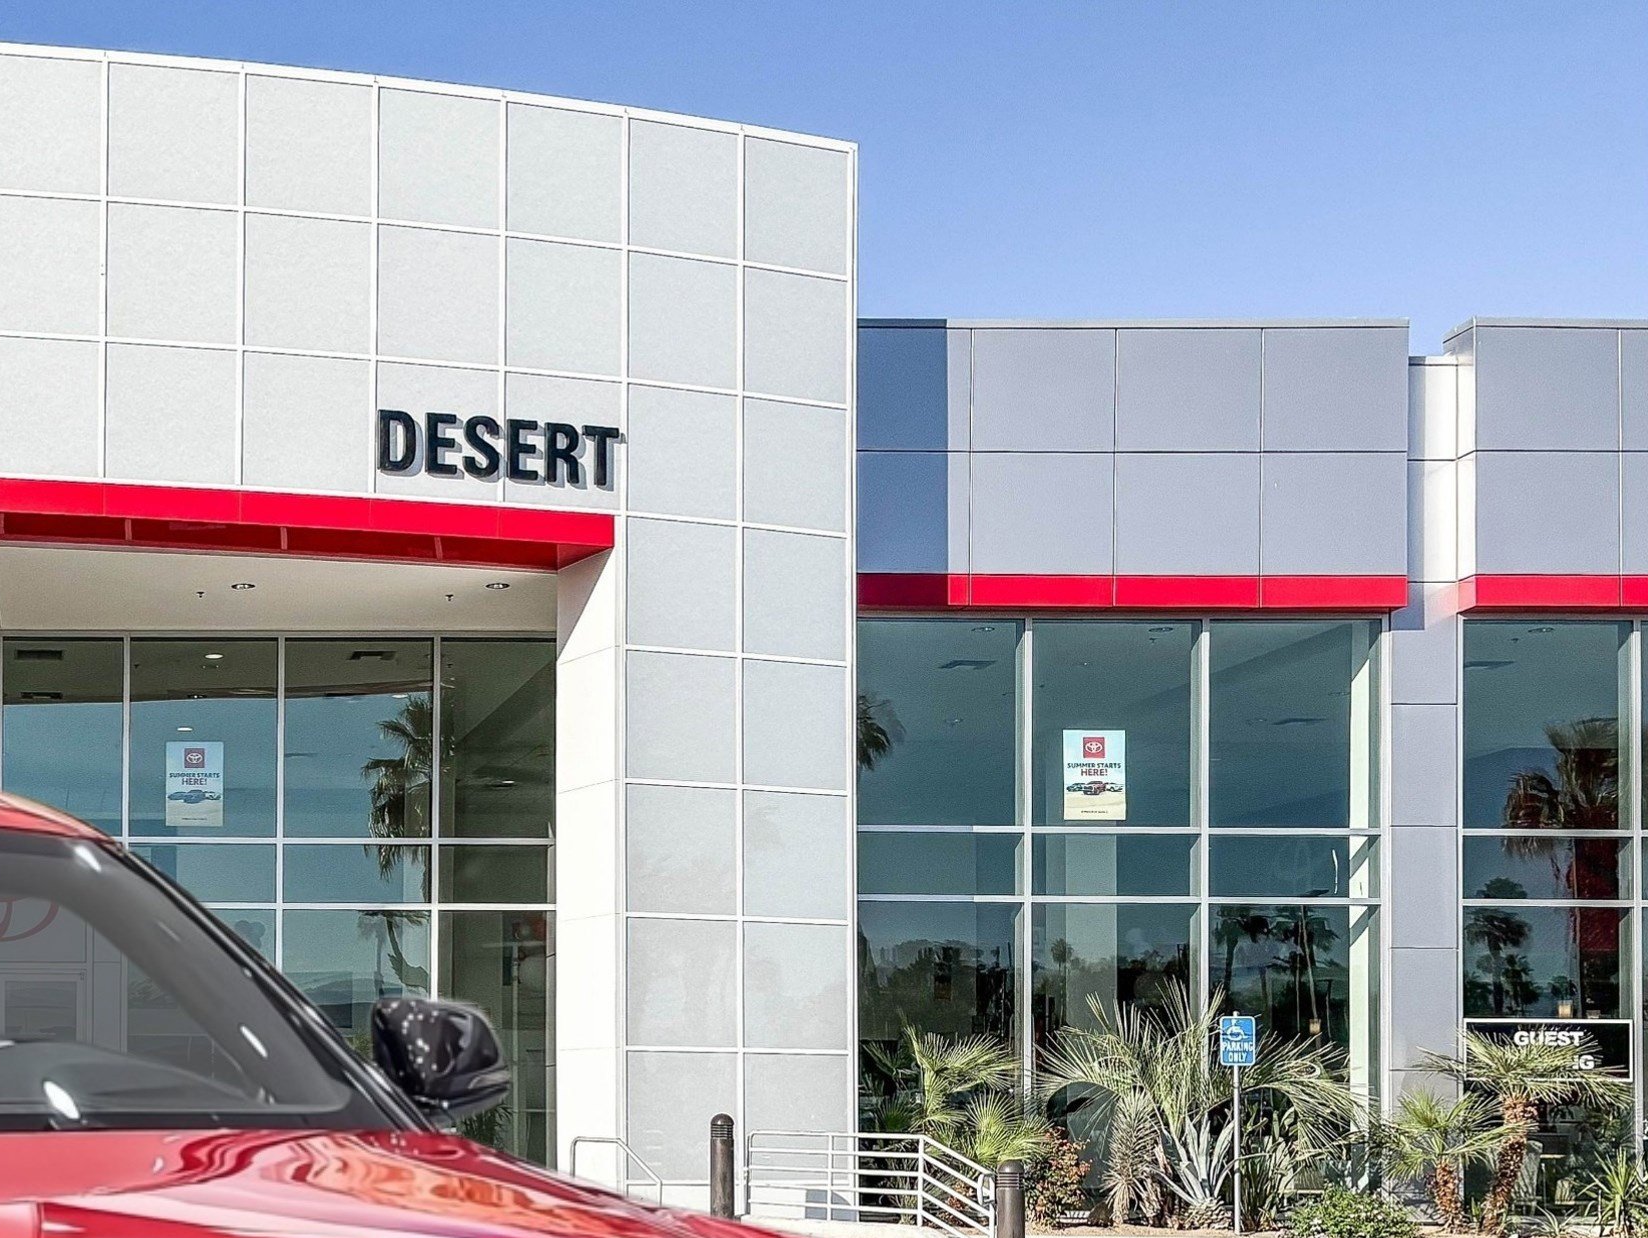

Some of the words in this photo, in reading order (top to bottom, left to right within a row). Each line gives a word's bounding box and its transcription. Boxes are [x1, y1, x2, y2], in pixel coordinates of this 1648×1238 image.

[377, 409, 620, 487] DESERT
[1080, 768, 1108, 776] HERE!
[181, 778, 208, 786] HERE!
[1513, 1030, 1585, 1047] GUEST
[1222, 1041, 1253, 1052] PARKING
[1228, 1052, 1247, 1063] ONLY
